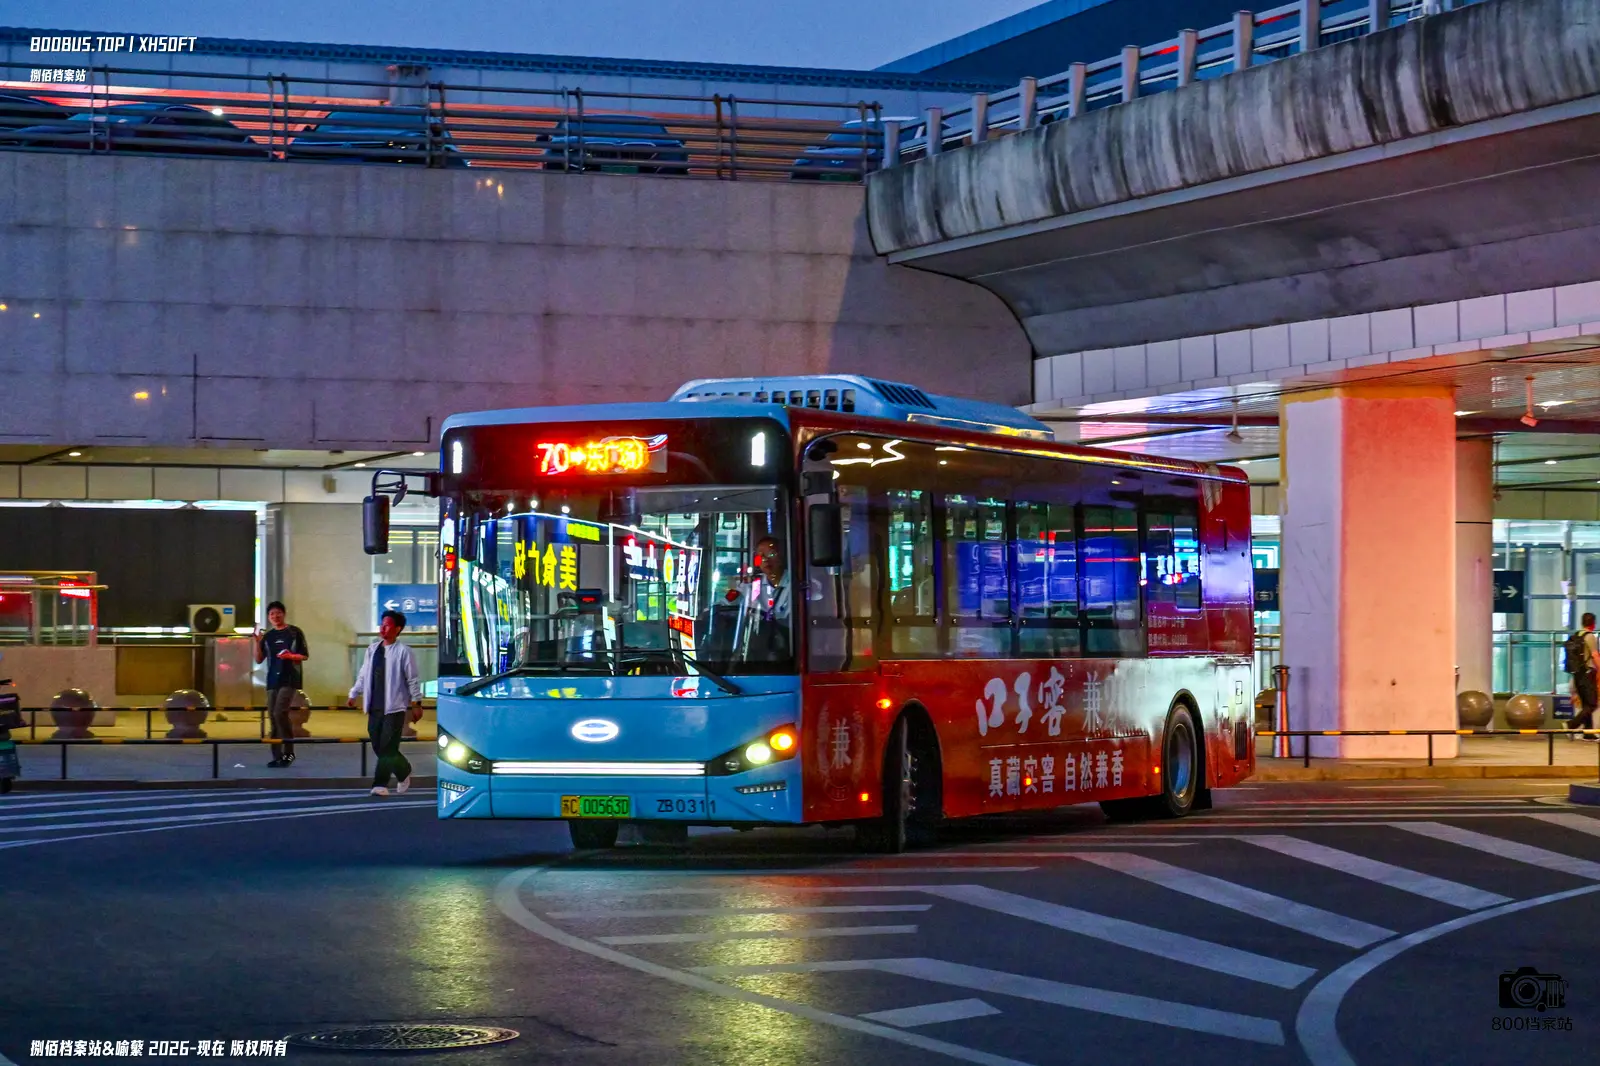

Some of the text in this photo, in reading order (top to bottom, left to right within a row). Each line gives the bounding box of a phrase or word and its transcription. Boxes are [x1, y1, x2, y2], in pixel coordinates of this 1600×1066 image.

[537, 442, 570, 473] 70
[1065, 749, 1124, 793] 自然兼香
[657, 799, 716, 815] ZB0311
